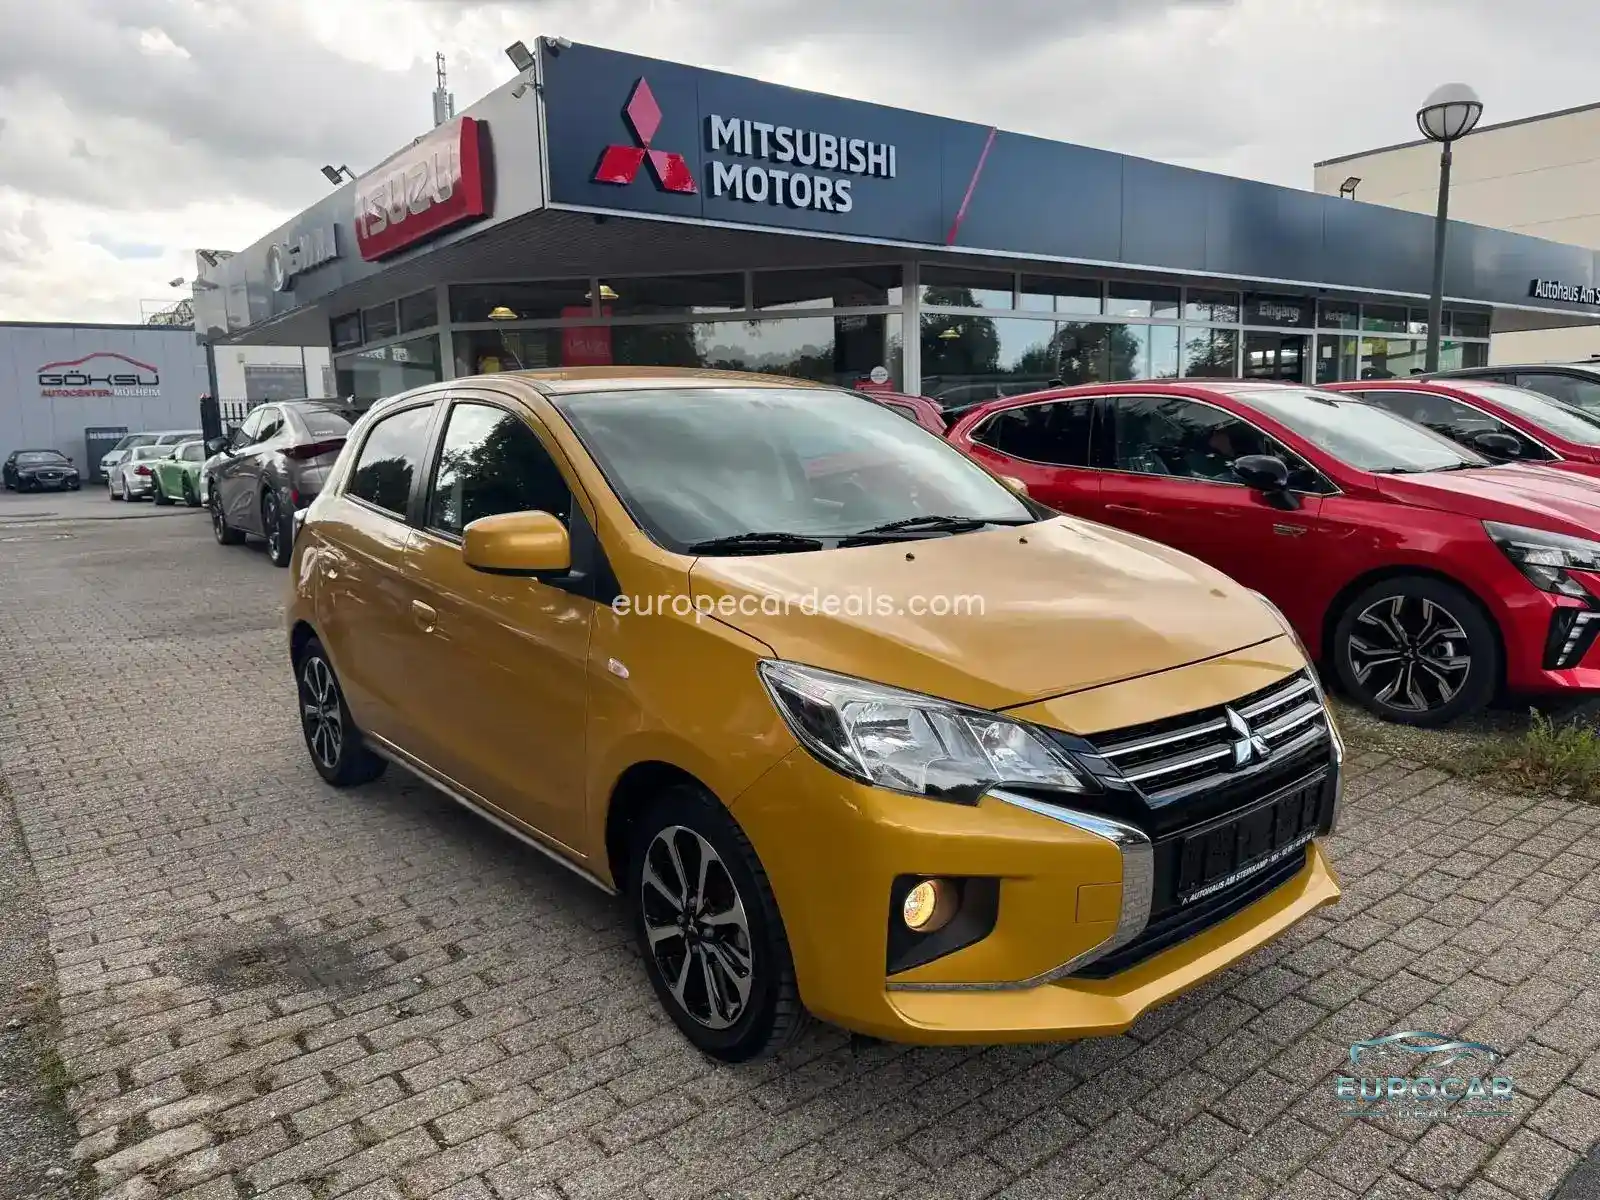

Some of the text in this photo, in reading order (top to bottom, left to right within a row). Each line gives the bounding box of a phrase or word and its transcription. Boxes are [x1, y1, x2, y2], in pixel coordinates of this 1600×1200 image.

[709, 114, 896, 178] MITSUBISHI
[360, 146, 453, 240] ISUZU
[712, 160, 853, 213] MOTORS
[1258, 301, 1301, 323] Eingang
[1534, 278, 1579, 302] Autohaus
[1579, 284, 1595, 304] Am
[38, 369, 160, 386] GÖKSU
[1189, 880, 1225, 903] AUTOHAUS
[1224, 876, 1236, 888] AM
[1235, 858, 1269, 881] STEINKAMP
